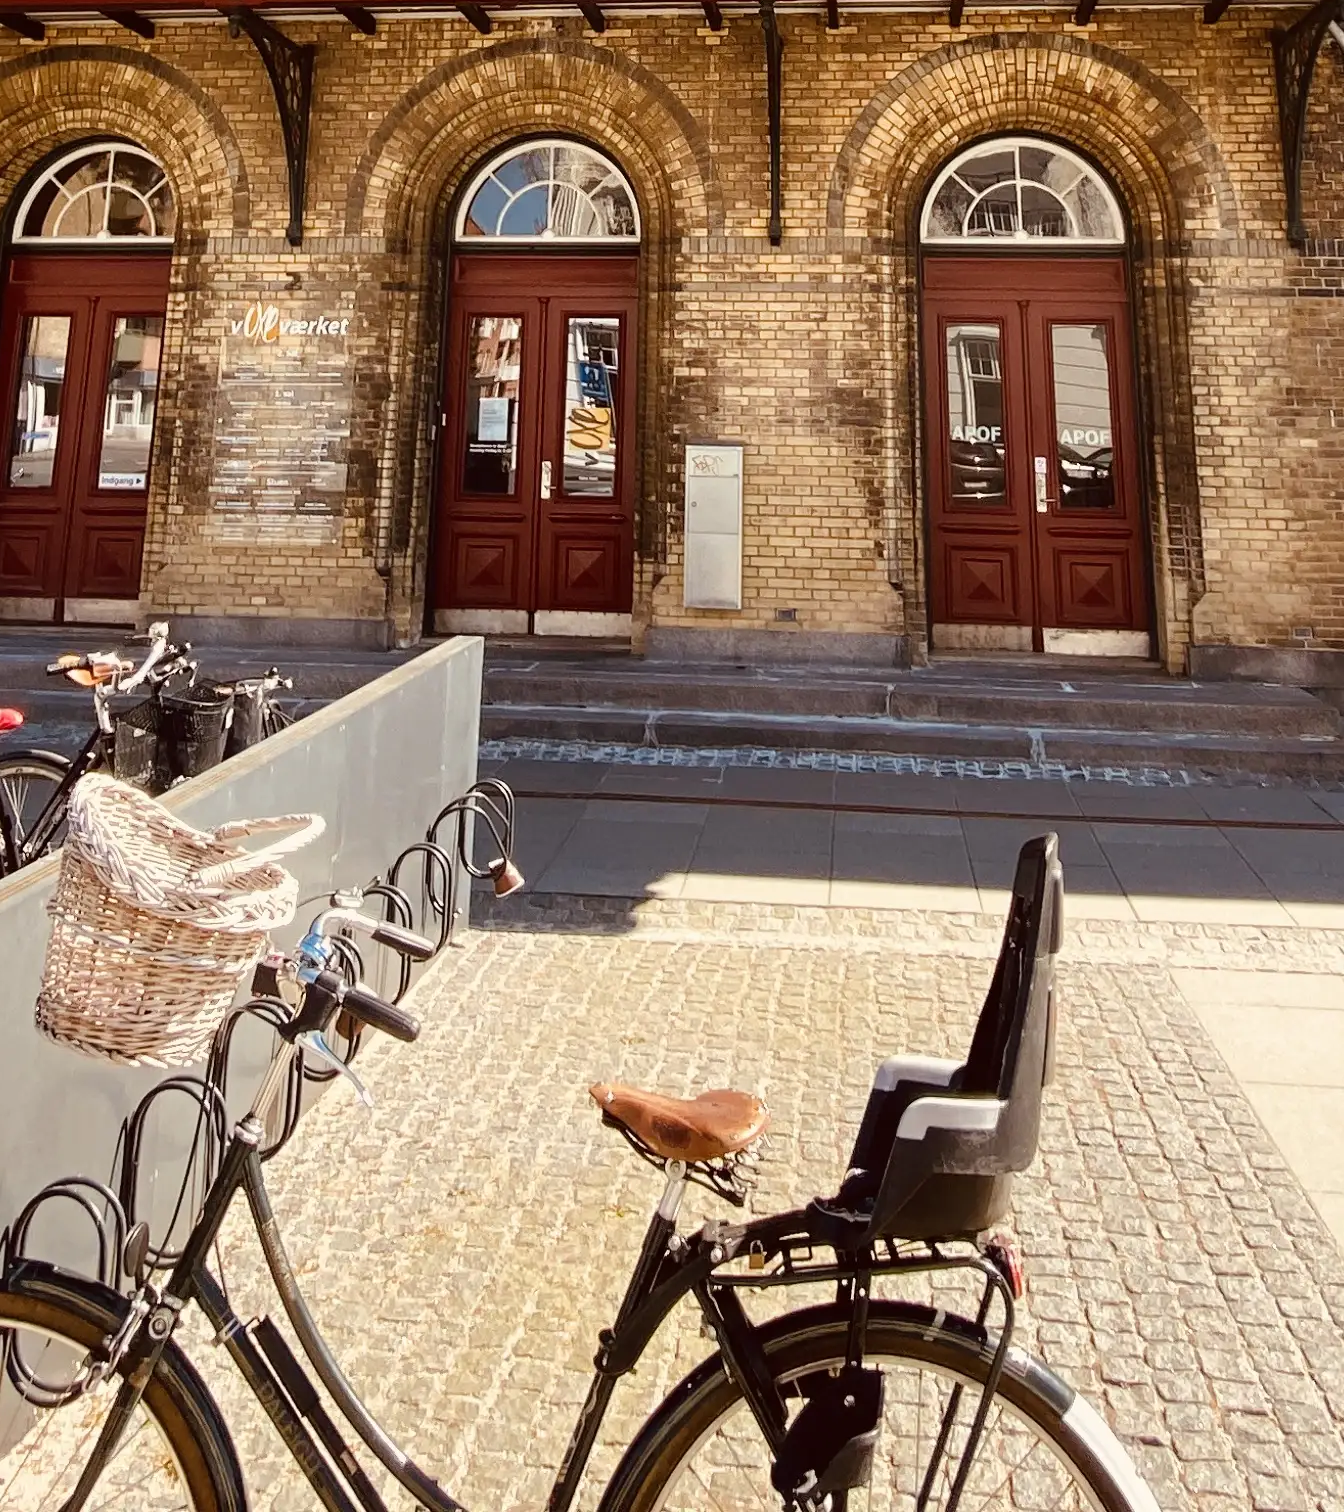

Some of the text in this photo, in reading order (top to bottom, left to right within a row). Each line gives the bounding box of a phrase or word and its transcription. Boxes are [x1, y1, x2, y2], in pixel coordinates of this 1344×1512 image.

[951, 426, 1002, 442] APOF
[1060, 429, 1112, 445] APOF
[102, 476, 134, 486] Indgang
